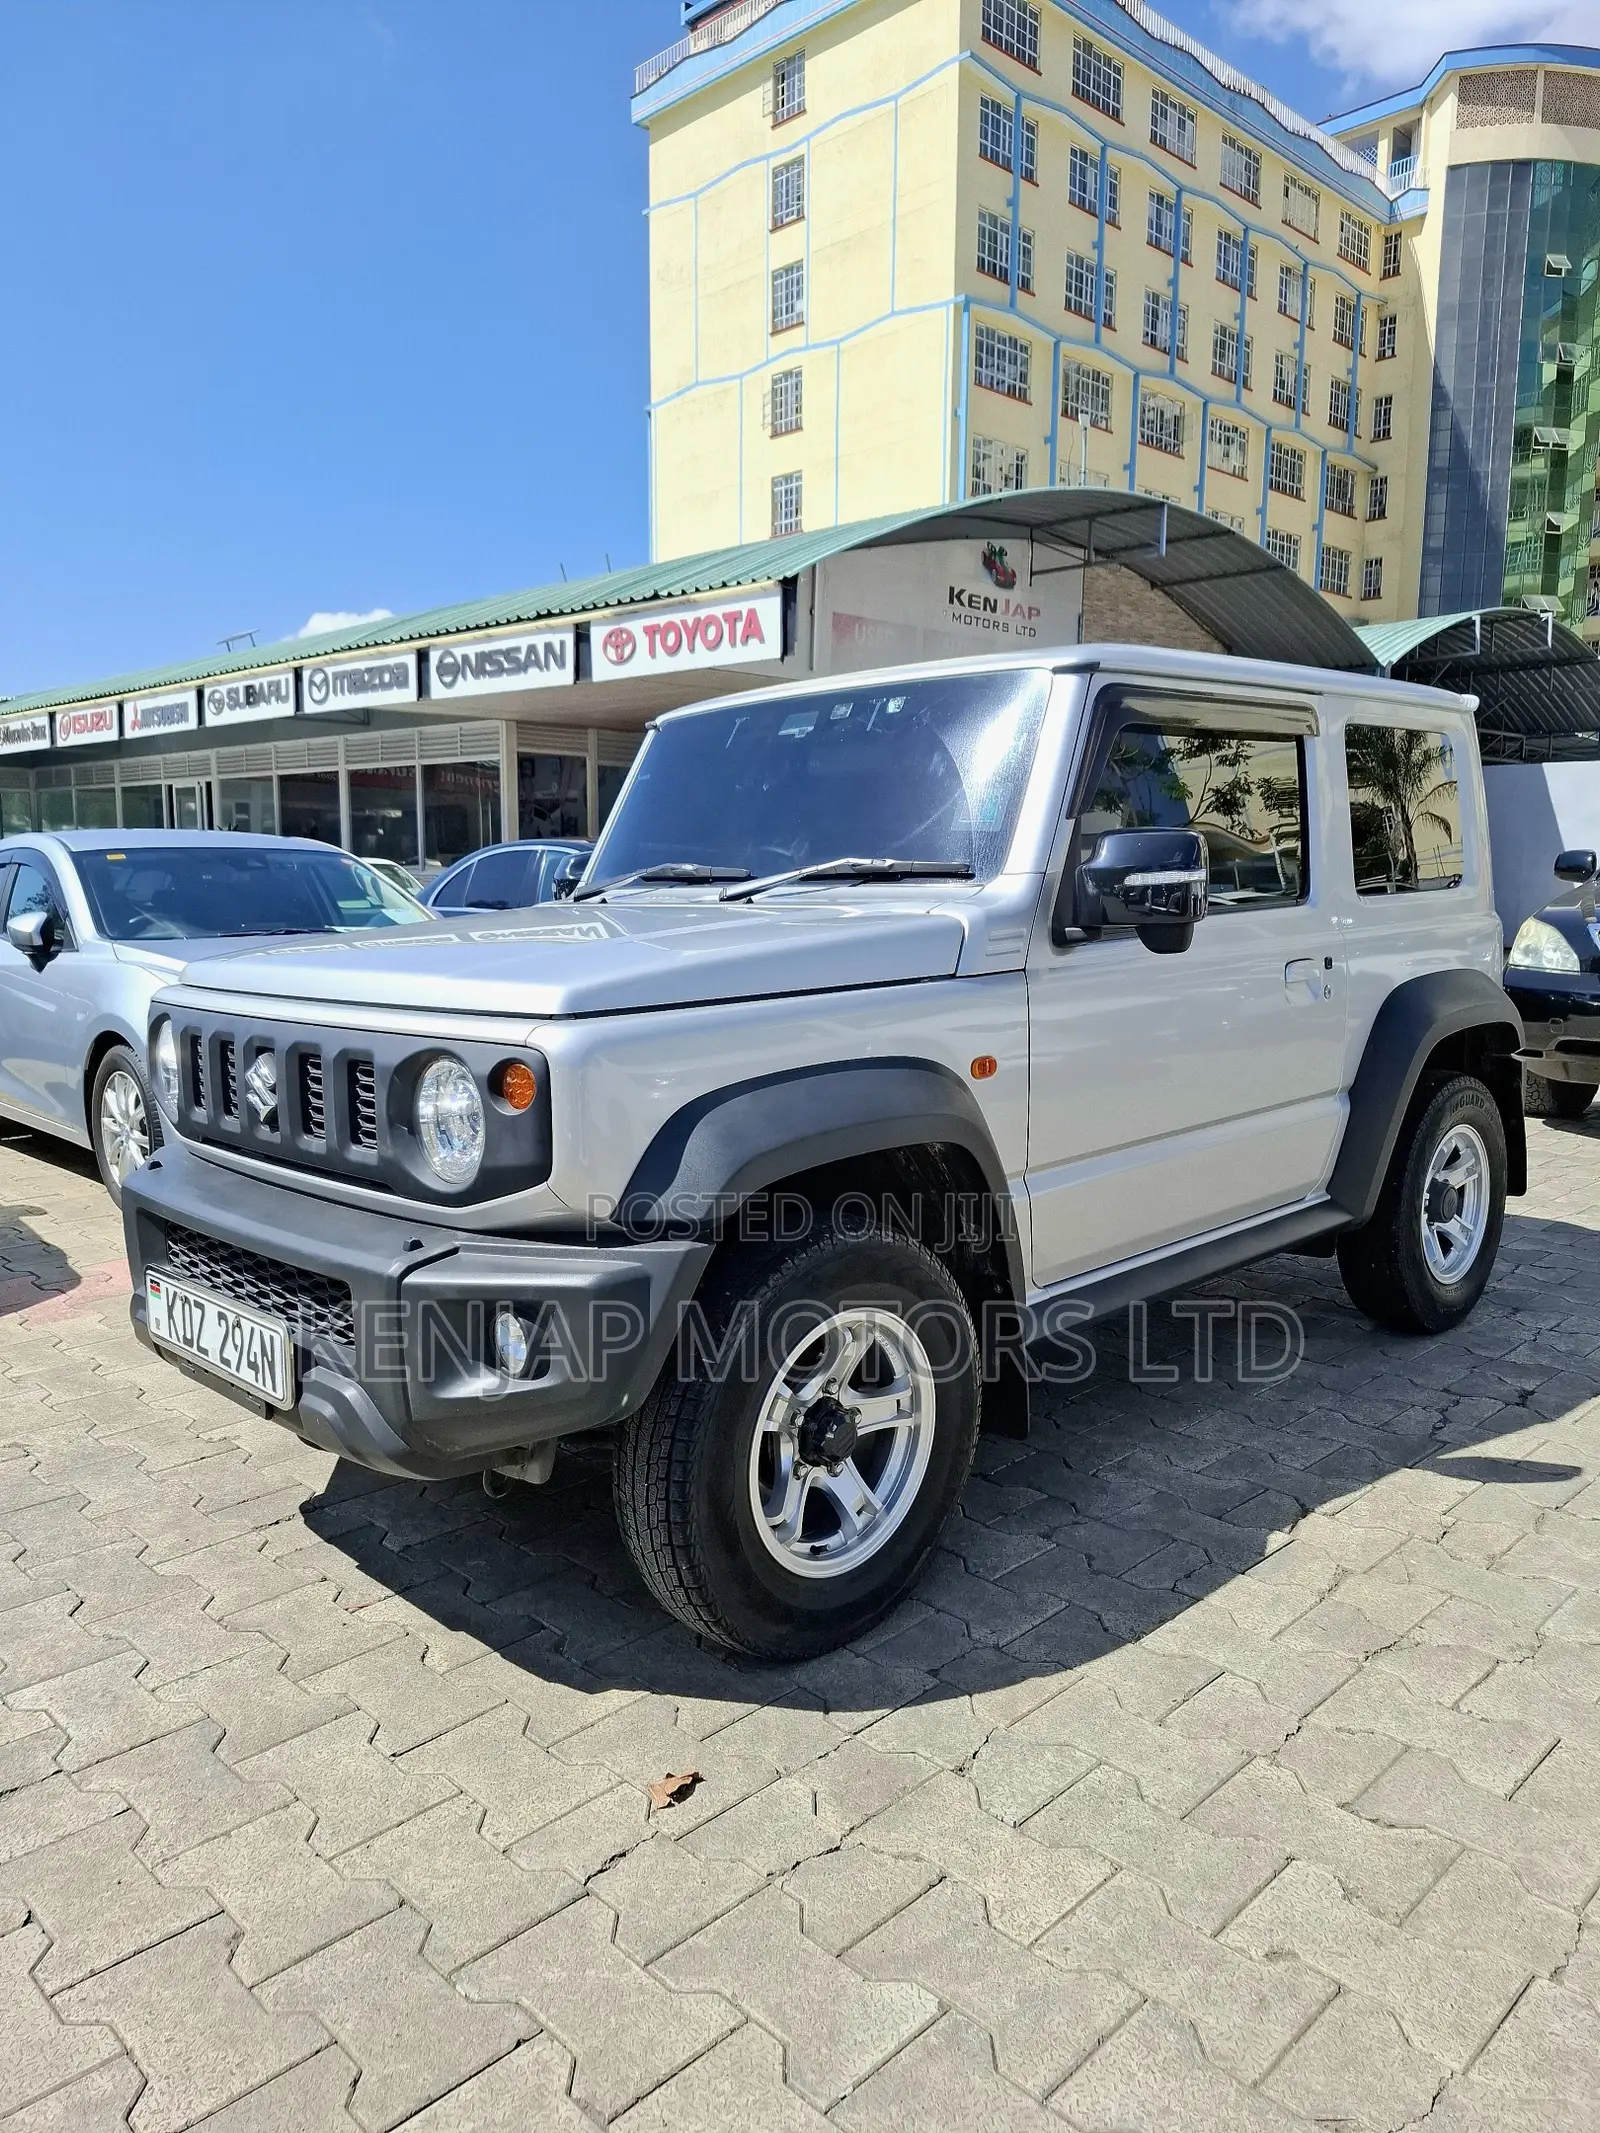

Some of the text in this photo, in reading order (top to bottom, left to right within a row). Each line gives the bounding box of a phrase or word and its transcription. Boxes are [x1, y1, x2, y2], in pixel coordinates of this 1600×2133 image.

[948, 586, 1041, 621] KENJAP
[642, 607, 766, 660] TOYOTA
[952, 612, 1037, 638] MOTORS LTD
[460, 640, 566, 682] NISSAN
[225, 679, 290, 711] SUBARU
[72, 710, 113, 735] ISUZU
[166, 1287, 277, 1394] KDZ 294N
